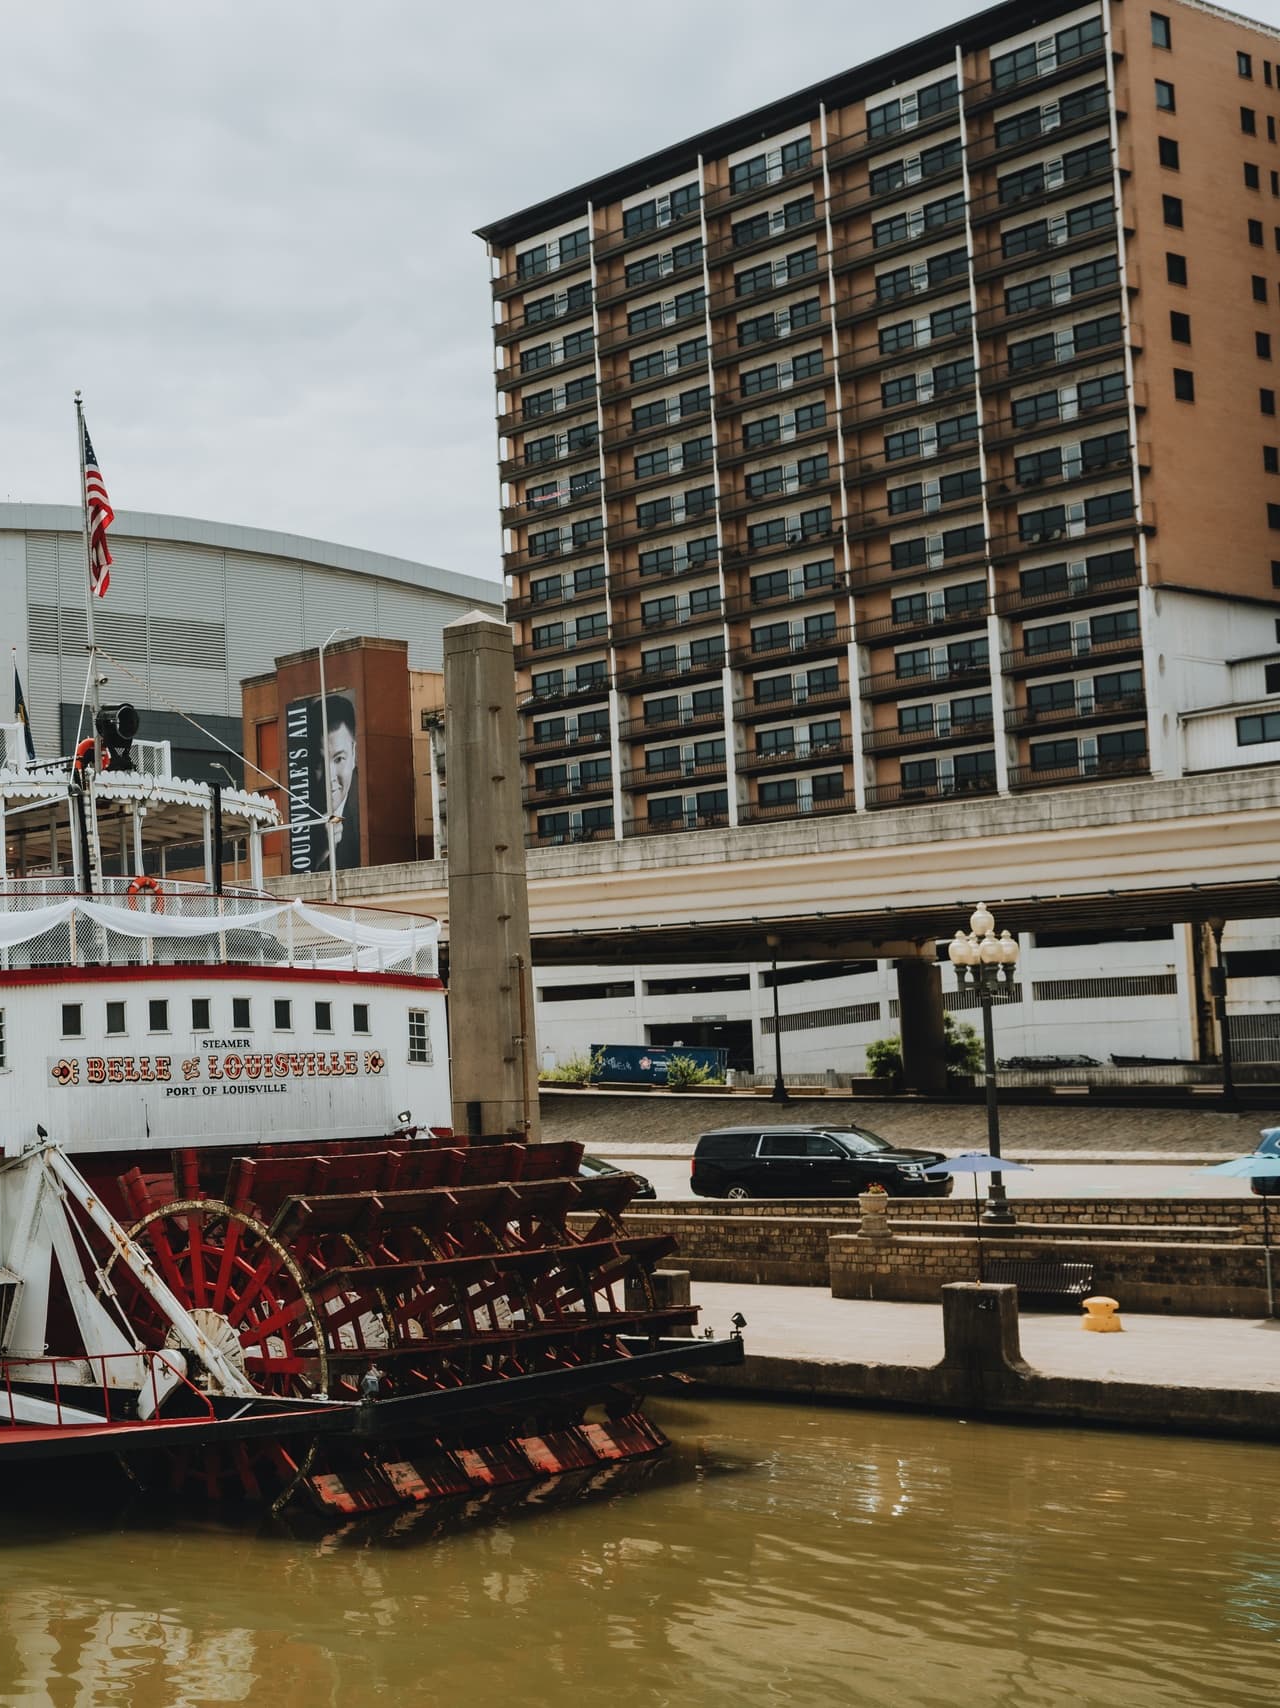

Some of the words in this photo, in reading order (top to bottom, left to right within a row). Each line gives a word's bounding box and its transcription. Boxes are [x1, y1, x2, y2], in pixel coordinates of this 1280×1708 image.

[288, 707, 308, 738] ALI
[288, 748, 312, 873] OUISVILLE'S
[202, 1039, 251, 1049] STEAMER
[86, 1055, 172, 1083] BELLE
[208, 1051, 359, 1080] LOUISVILLE
[166, 1086, 197, 1097] PORT
[202, 1086, 217, 1096] OF
[223, 1083, 288, 1095] LOUISVILLE
